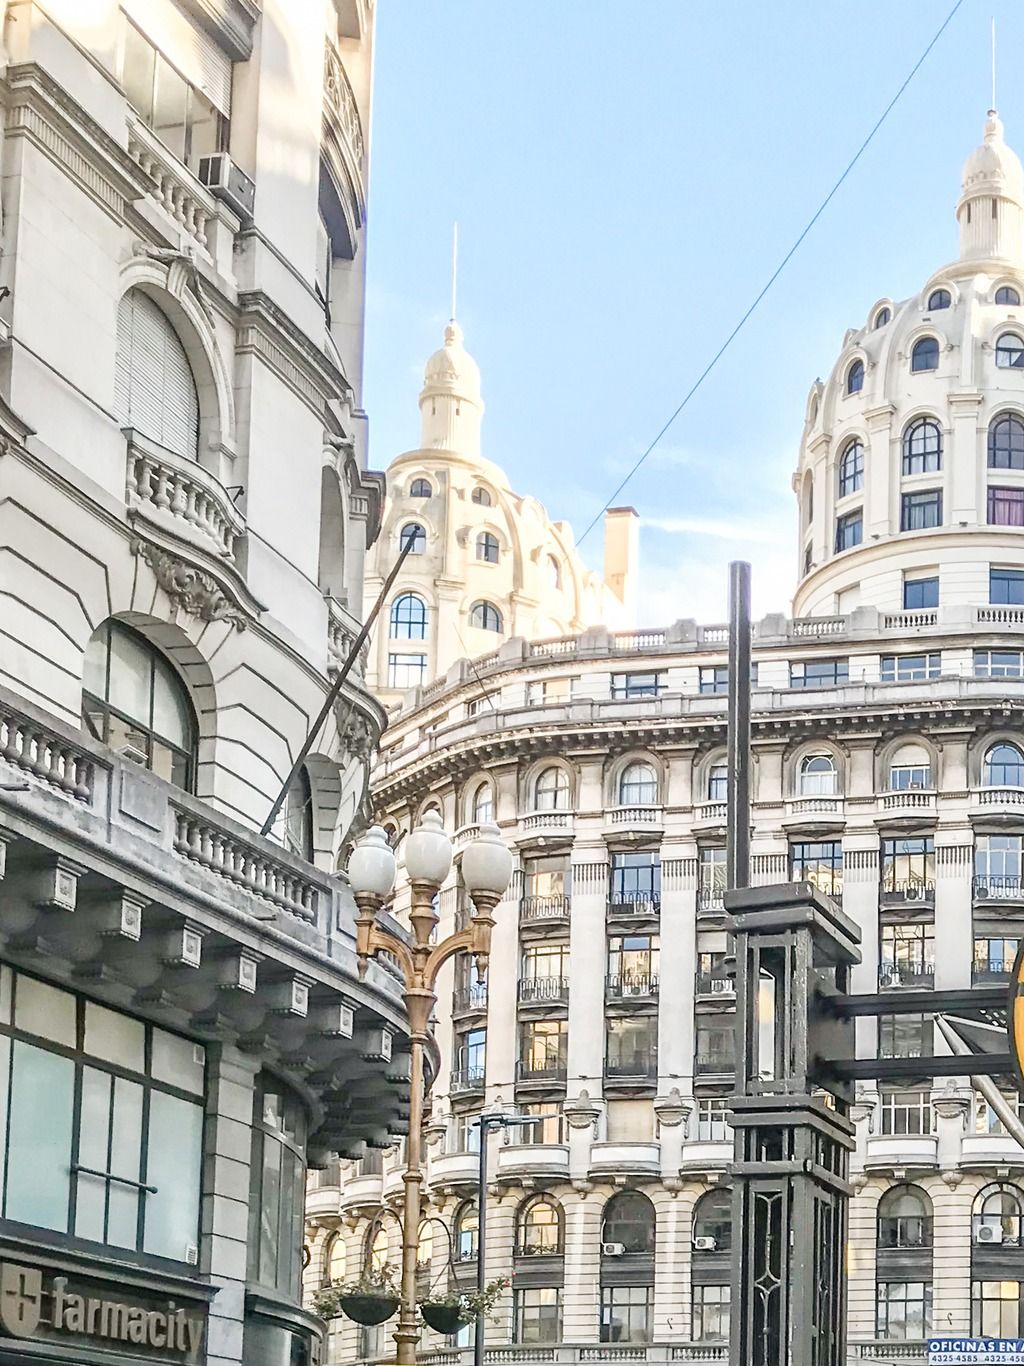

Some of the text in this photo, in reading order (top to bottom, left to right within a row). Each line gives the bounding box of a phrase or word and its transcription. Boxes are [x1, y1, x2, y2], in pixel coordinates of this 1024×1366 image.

[53, 1276, 203, 1366] farmacity
[929, 1342, 995, 1352] OFICINAS
[1000, 1342, 1017, 1352] EN
